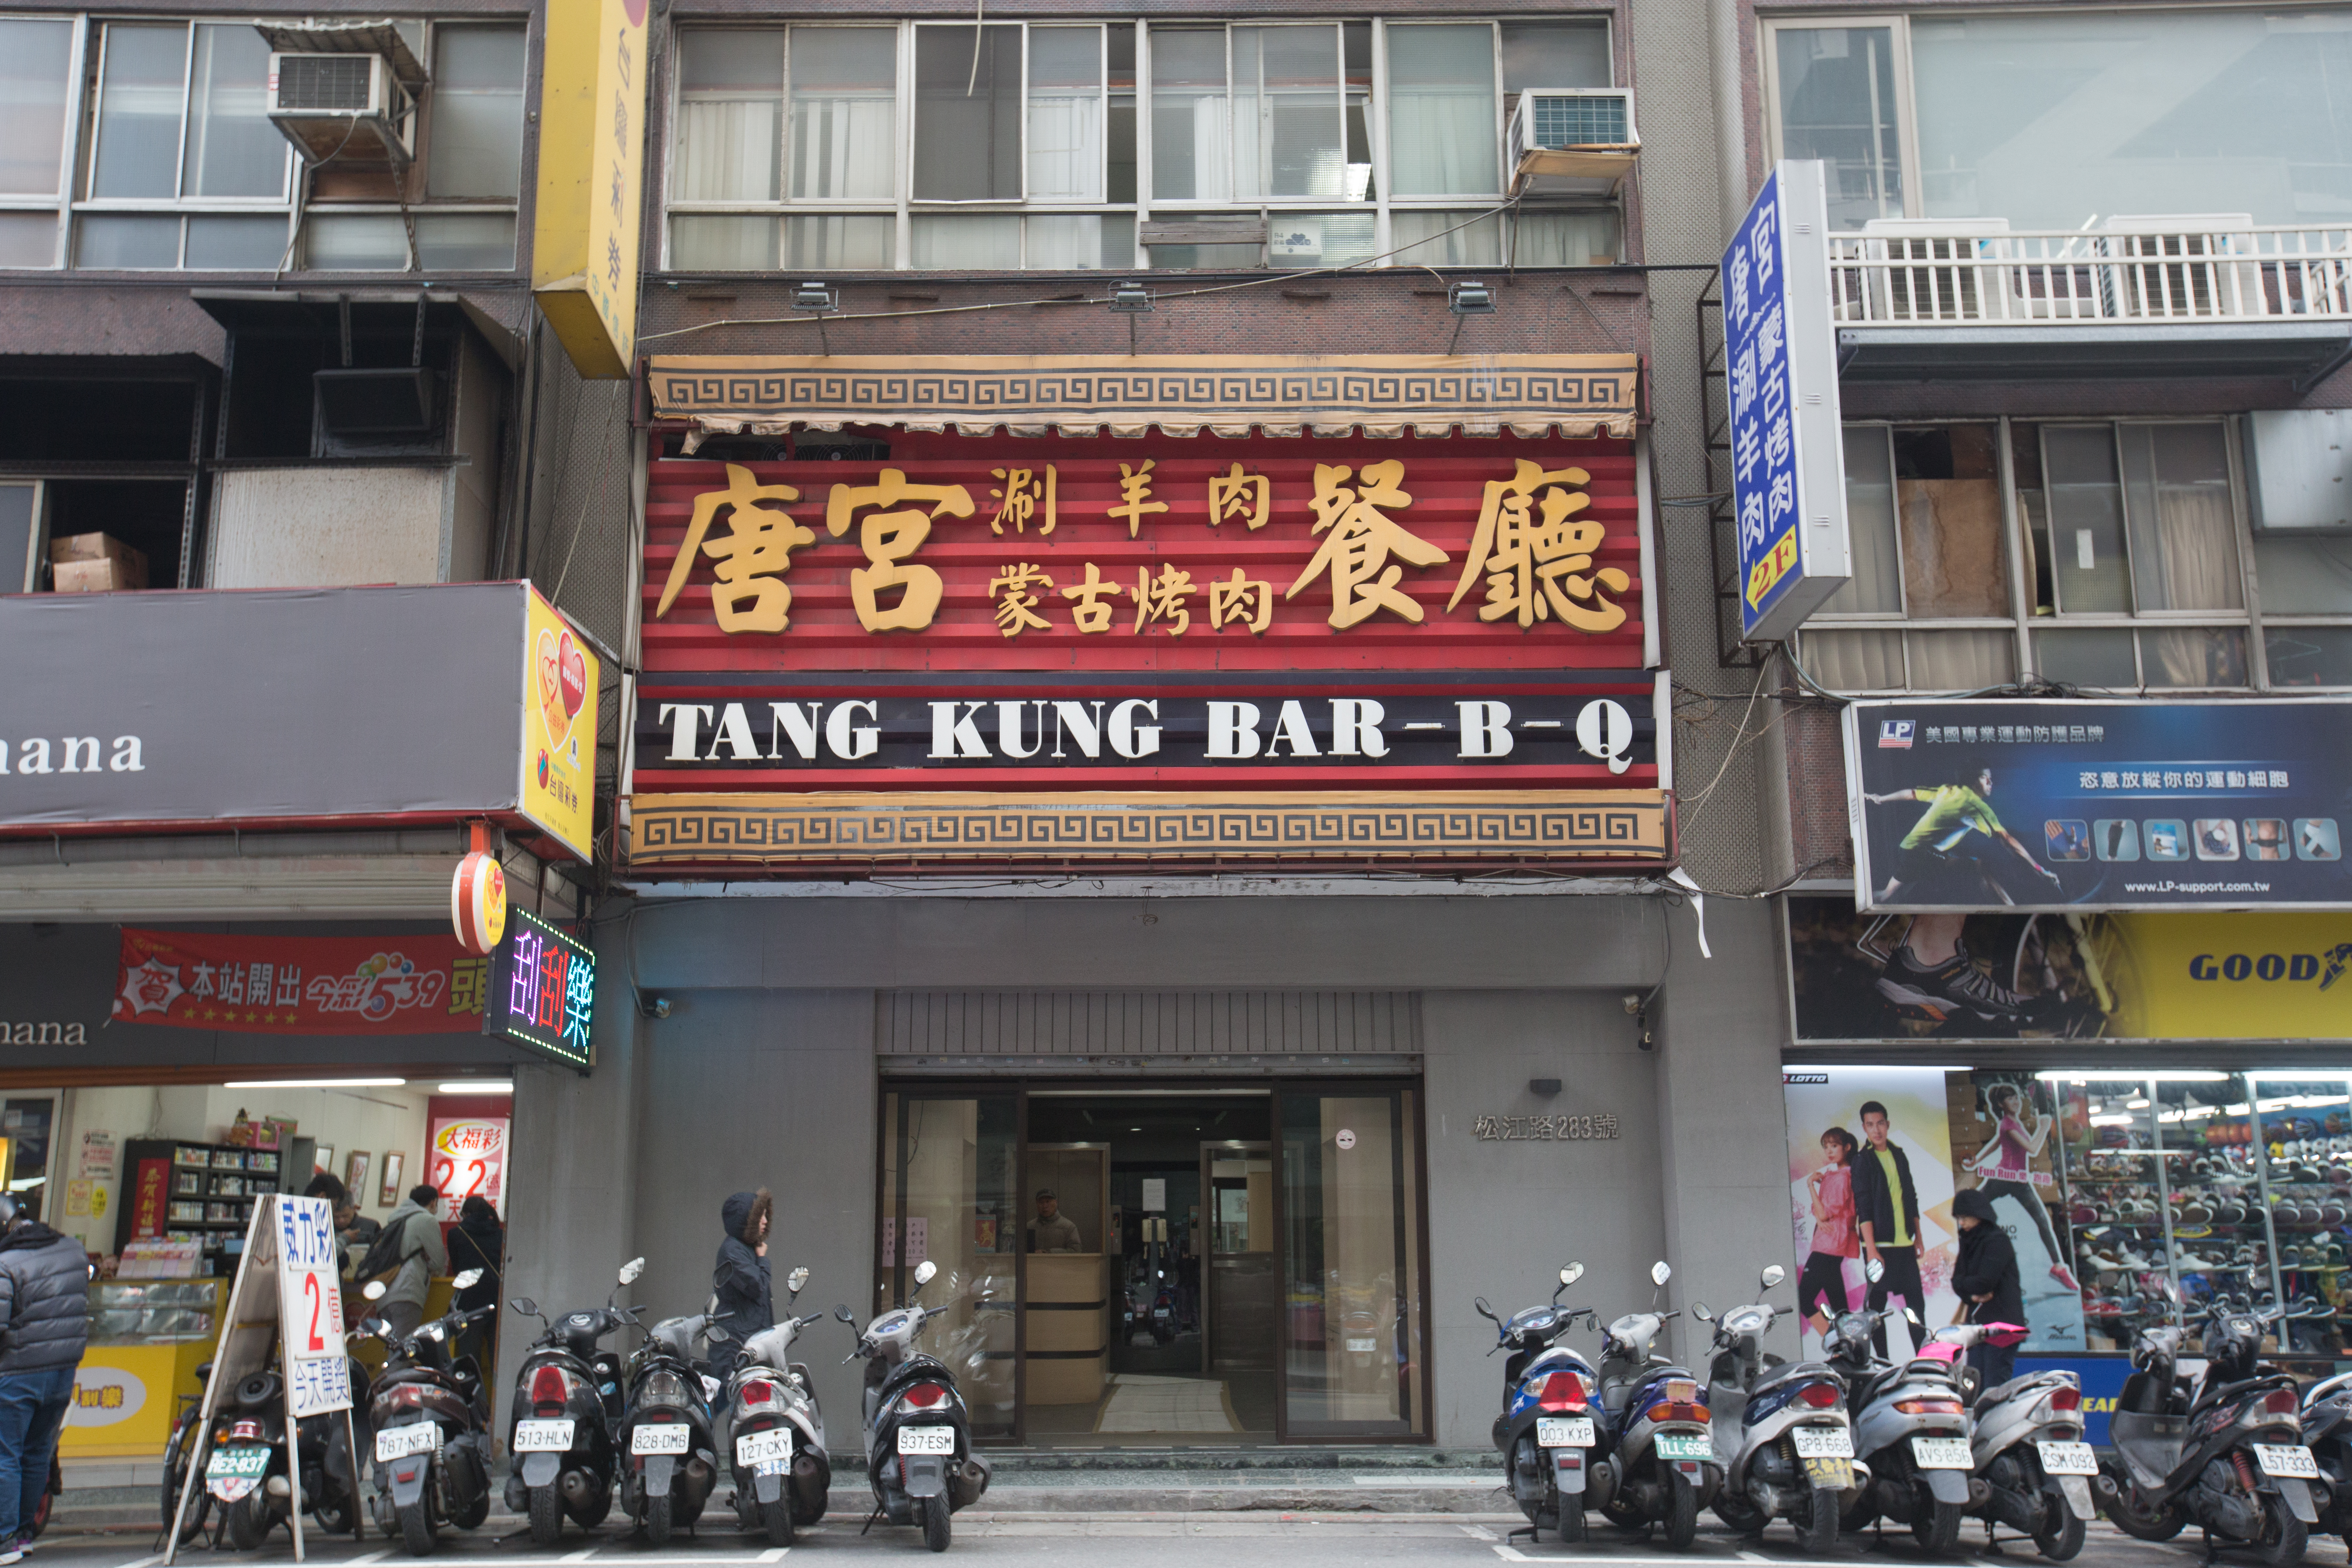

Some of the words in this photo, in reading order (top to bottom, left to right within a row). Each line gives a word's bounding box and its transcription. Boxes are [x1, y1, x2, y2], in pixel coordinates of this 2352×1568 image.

[1728, 200, 1775, 331] 唐宮
[1758, 302, 1793, 533] 蒙古烤肉
[1732, 339, 1765, 563] 涮羊肉
[989, 458, 1270, 538] 涮羊肉
[656, 462, 976, 634] 唐宮
[1286, 458, 1630, 634] 餐廳
[1753, 534, 1793, 602] 2F
[988, 562, 1272, 637] 蒙古烤肉
[0, 735, 146, 775] ana
[658, 700, 881, 761] TANG
[926, 699, 1163, 760] KUNG
[1882, 722, 1911, 737] LP
[1925, 725, 2104, 744] 美國專業運動防護品牌
[550, 774, 578, 814] 台灣彩券
[2079, 771, 2289, 789] 恣意放縱你的運動細胞
[2124, 881, 2270, 893] www.LP-support.com.tw
[135, 968, 174, 1007] 賀
[189, 960, 301, 1008] 本站開出
[511, 930, 593, 1047] 刮刮樂
[2189, 954, 2319, 981] GOOD
[438, 1128, 501, 1149] 大福彩
[1475, 1113, 1619, 1140] 松江路283號
[1978, 1166, 1995, 1177] Fun
[1998, 1168, 2016, 1179] Run
[282, 1200, 332, 1264] 威力彩
[305, 1272, 324, 1351] 2
[328, 1285, 342, 1334] 億
[295, 1356, 348, 1409] 今天開獎
